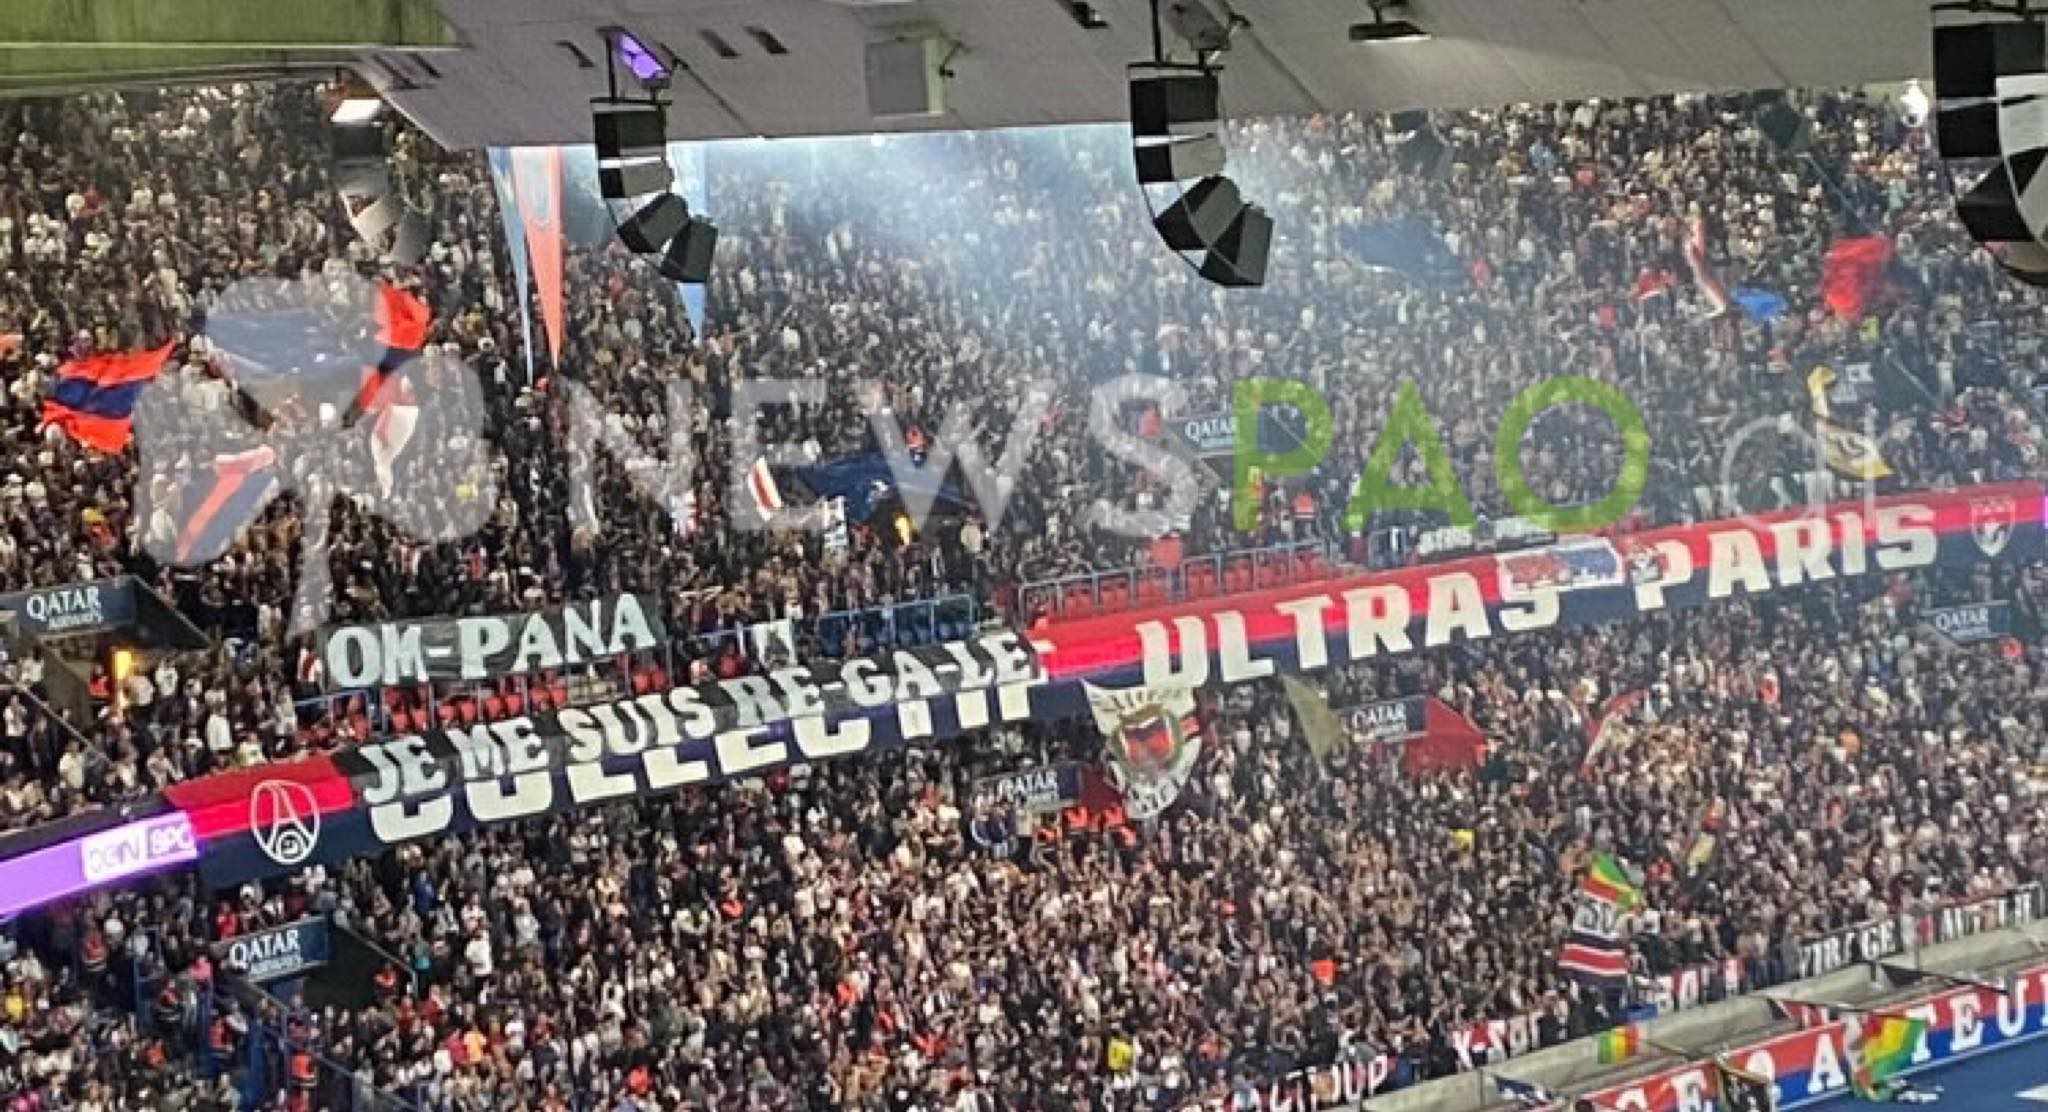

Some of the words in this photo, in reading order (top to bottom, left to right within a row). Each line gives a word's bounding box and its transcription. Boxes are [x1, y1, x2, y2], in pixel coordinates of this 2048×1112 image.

[26, 586, 100, 622] QATAR
[327, 593, 656, 688] OM-PANA
[1136, 570, 1562, 690] ULTRAS
[1634, 503, 1937, 612] PARIS
[360, 735, 447, 803] JE
[446, 716, 550, 779] ME
[557, 687, 716, 761] SUIS
[229, 929, 300, 969] QATAR
